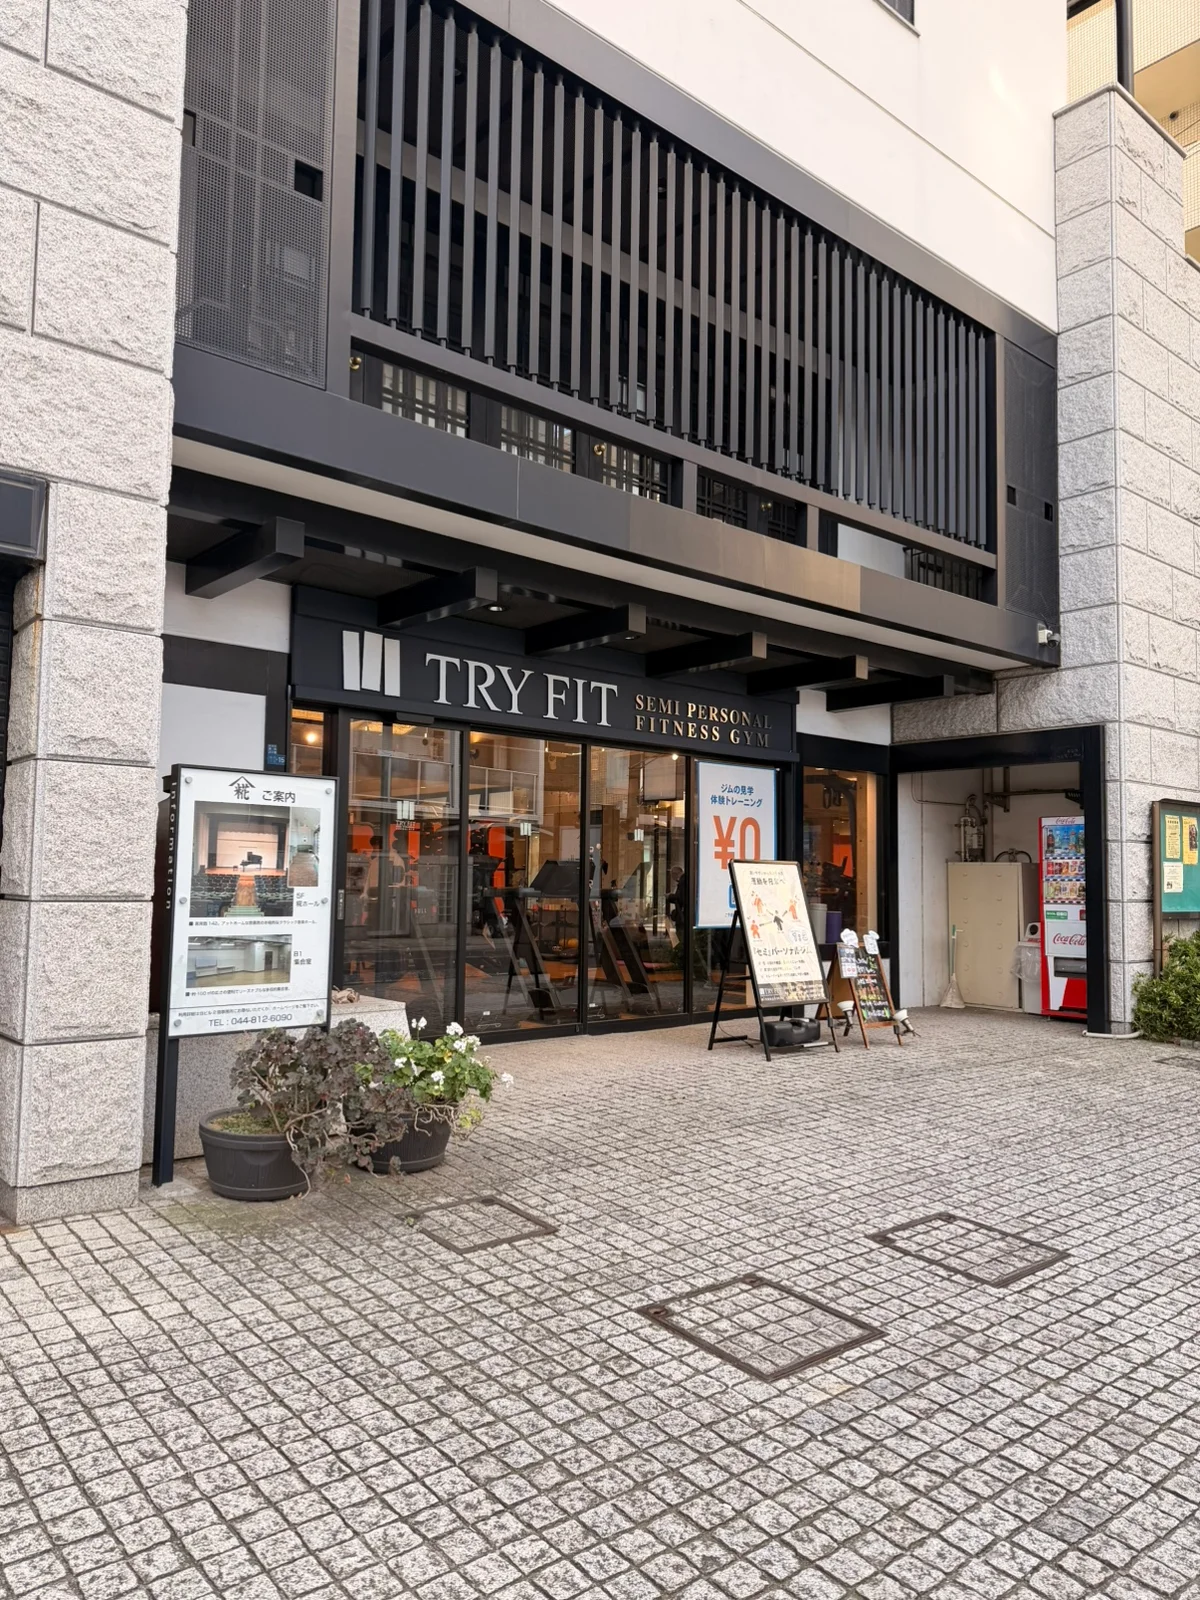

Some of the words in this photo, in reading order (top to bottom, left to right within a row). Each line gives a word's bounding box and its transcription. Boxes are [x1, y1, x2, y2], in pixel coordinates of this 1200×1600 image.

[425, 653, 534, 715] TRY
[543, 673, 618, 727] FIT
[635, 694, 680, 716] SEMI
[687, 702, 772, 730] PERSONAL
[635, 714, 720, 742] FITNESS
[729, 728, 769, 748] GYM
[262, 790, 296, 803] ご案内
[710, 795, 763, 807] 体験トレーニング
[720, 784, 755, 796] ジムの見学
[713, 815, 760, 870] ¥0
[209, 1019, 224, 1027] TEL
[231, 1013, 293, 1026] 044-812-6090
